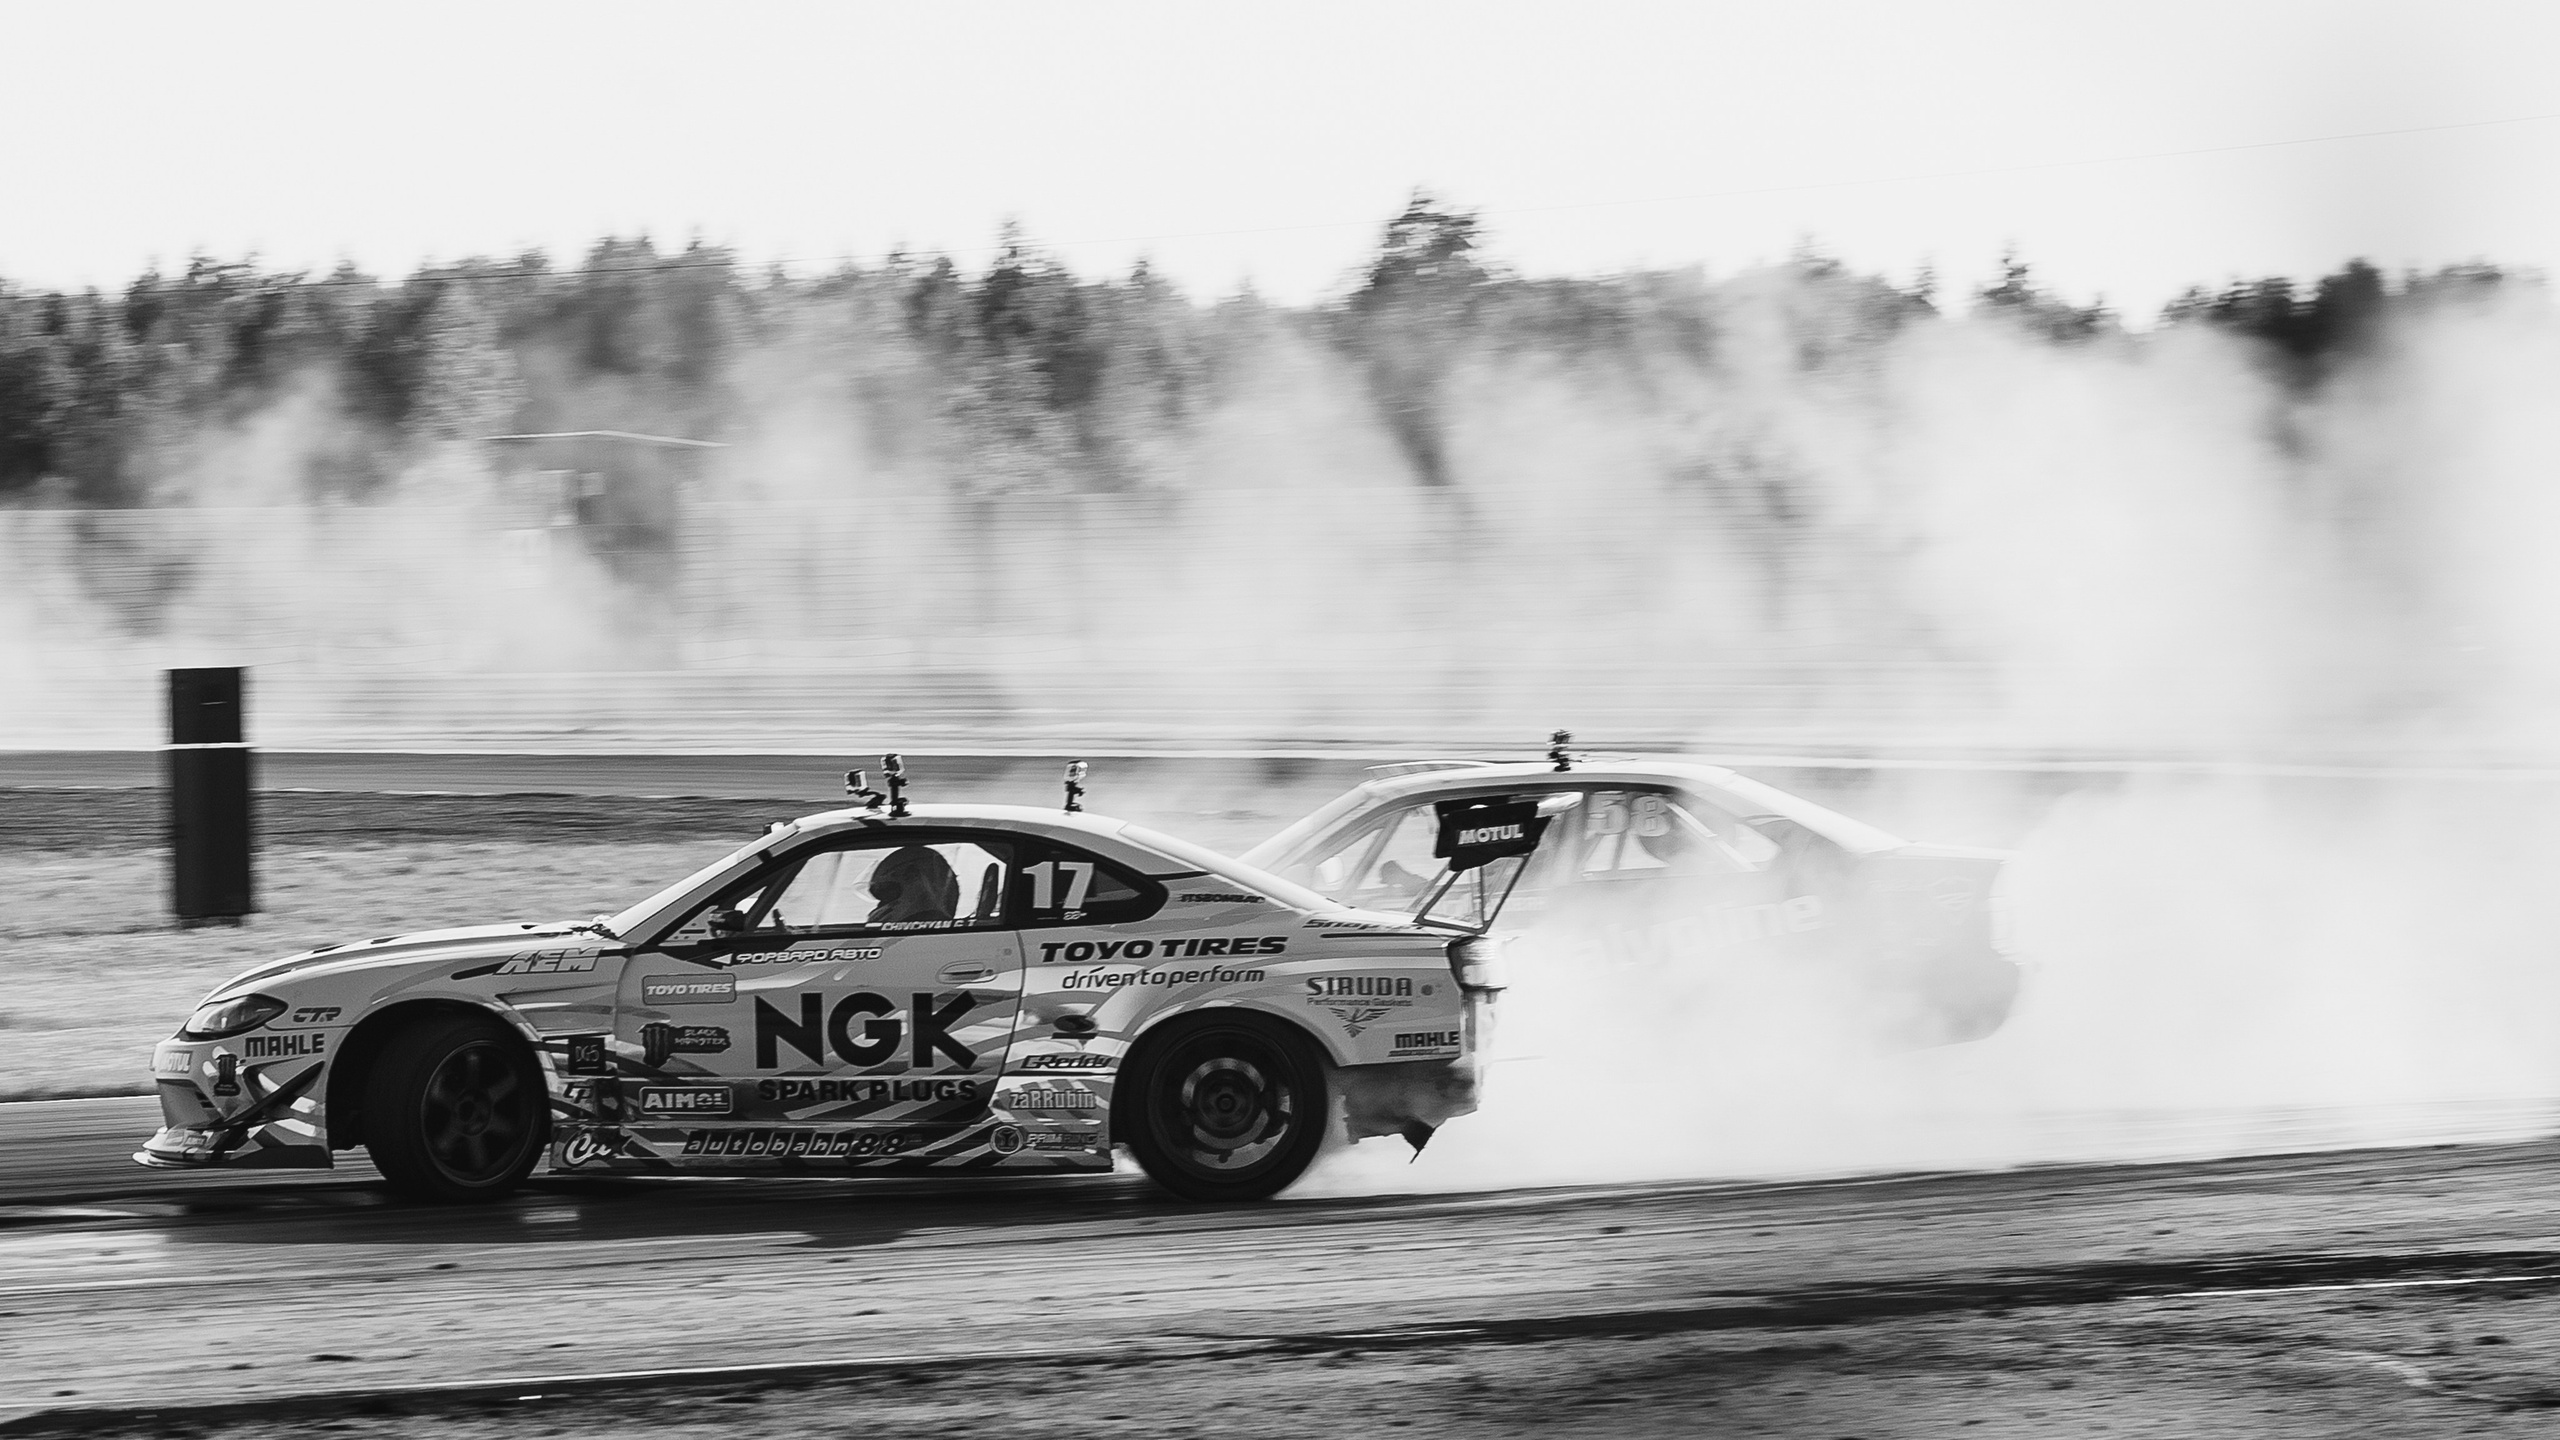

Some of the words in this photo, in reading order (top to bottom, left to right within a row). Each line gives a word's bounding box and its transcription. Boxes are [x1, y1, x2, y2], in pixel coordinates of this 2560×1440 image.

[1585, 793, 1672, 839] 58
[1457, 824, 1524, 846] MOTUL
[1022, 861, 1094, 909] 17
[493, 946, 603, 975] AEM
[1040, 939, 1154, 963] TOYO
[1160, 936, 1289, 958] TIRES
[646, 984, 688, 996] TOYO
[688, 982, 733, 994] TIRES
[1306, 976, 1413, 997] SIRUDA
[755, 989, 978, 1070] NGK
[1395, 1031, 1460, 1049] MAHLE
[245, 1033, 325, 1058] MAHLE
[160, 1052, 191, 1073] OTUL
[643, 1093, 729, 1109] AIMOL
[757, 1079, 866, 1101] SPARK
[868, 1079, 978, 1101] PLUGS
